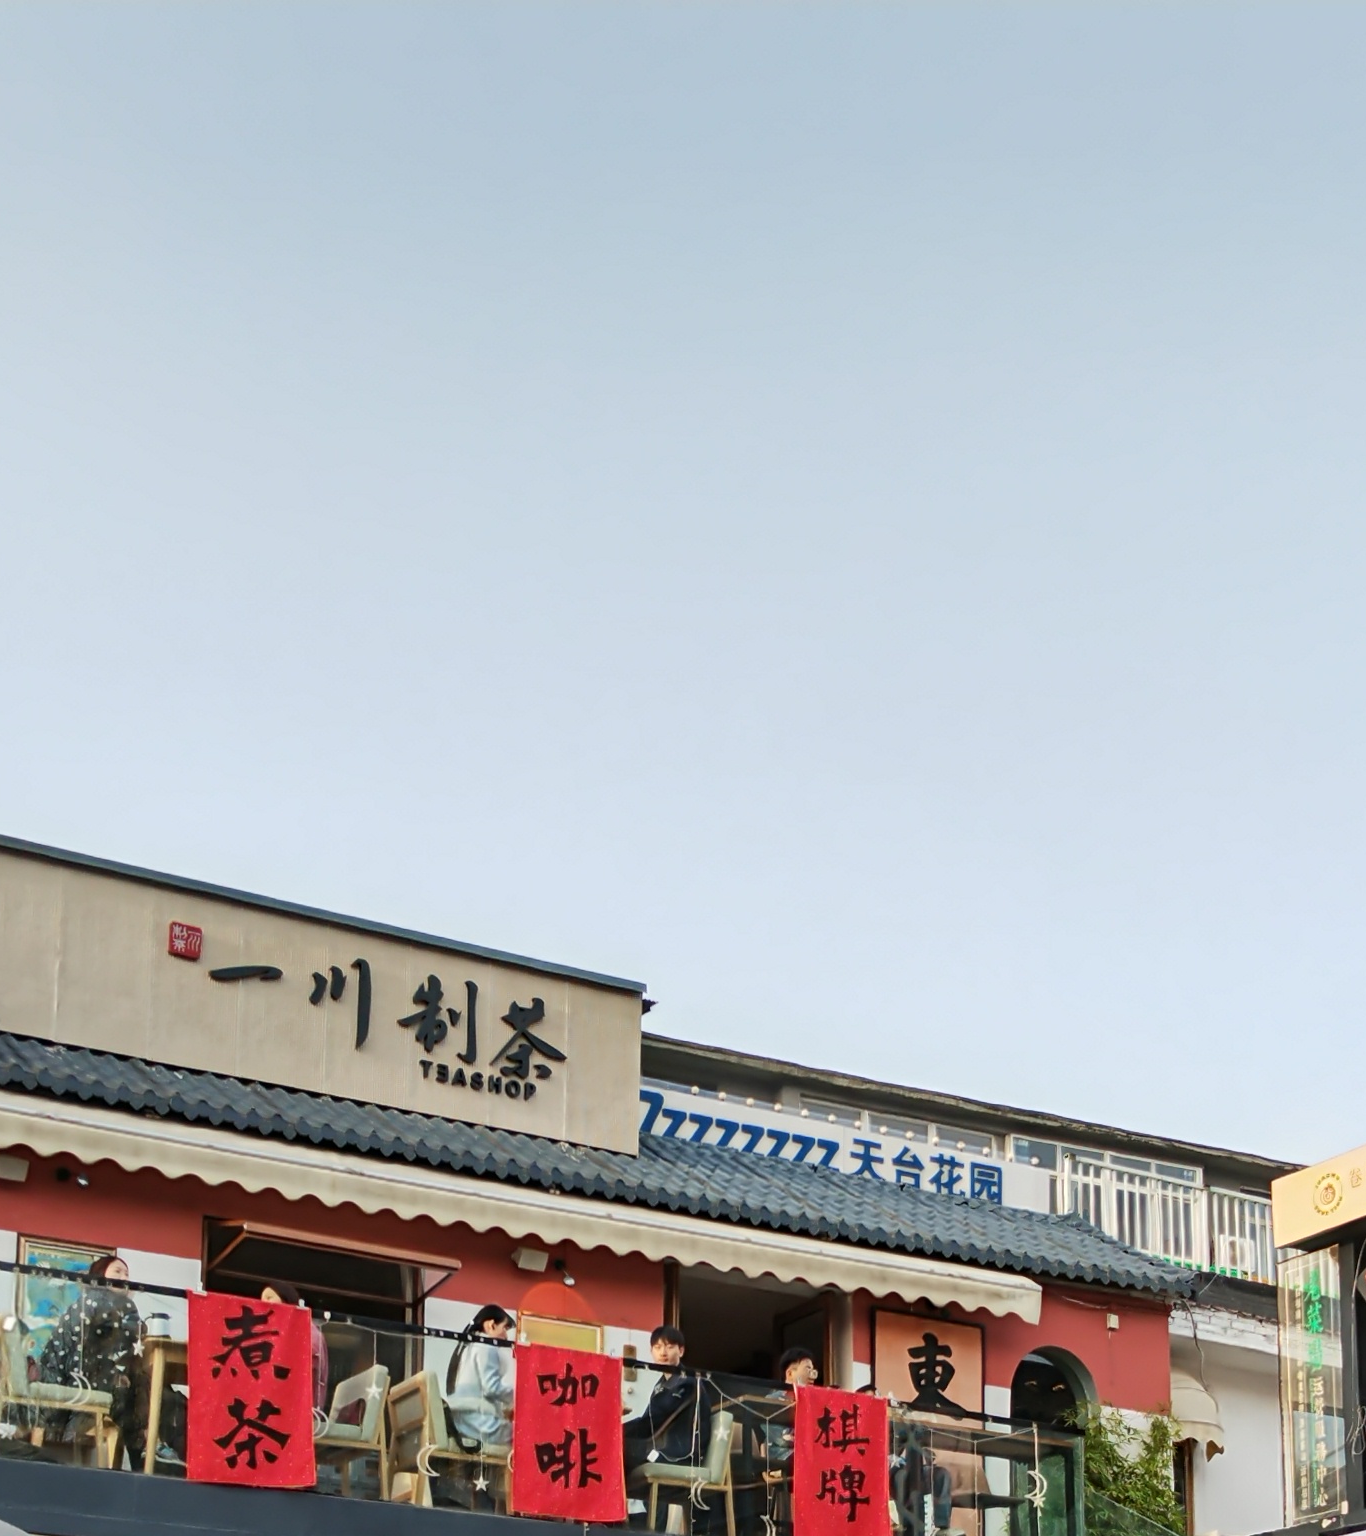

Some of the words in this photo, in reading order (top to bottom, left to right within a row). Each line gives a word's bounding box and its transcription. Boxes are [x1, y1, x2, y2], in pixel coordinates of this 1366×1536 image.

[209, 957, 567, 1081] 一川制茶
[849, 1137, 1004, 1206] 天台花园
[211, 1304, 292, 1471] 煮茶
[535, 1362, 603, 1490] 咖啡
[814, 1403, 871, 1523] 棋牌
